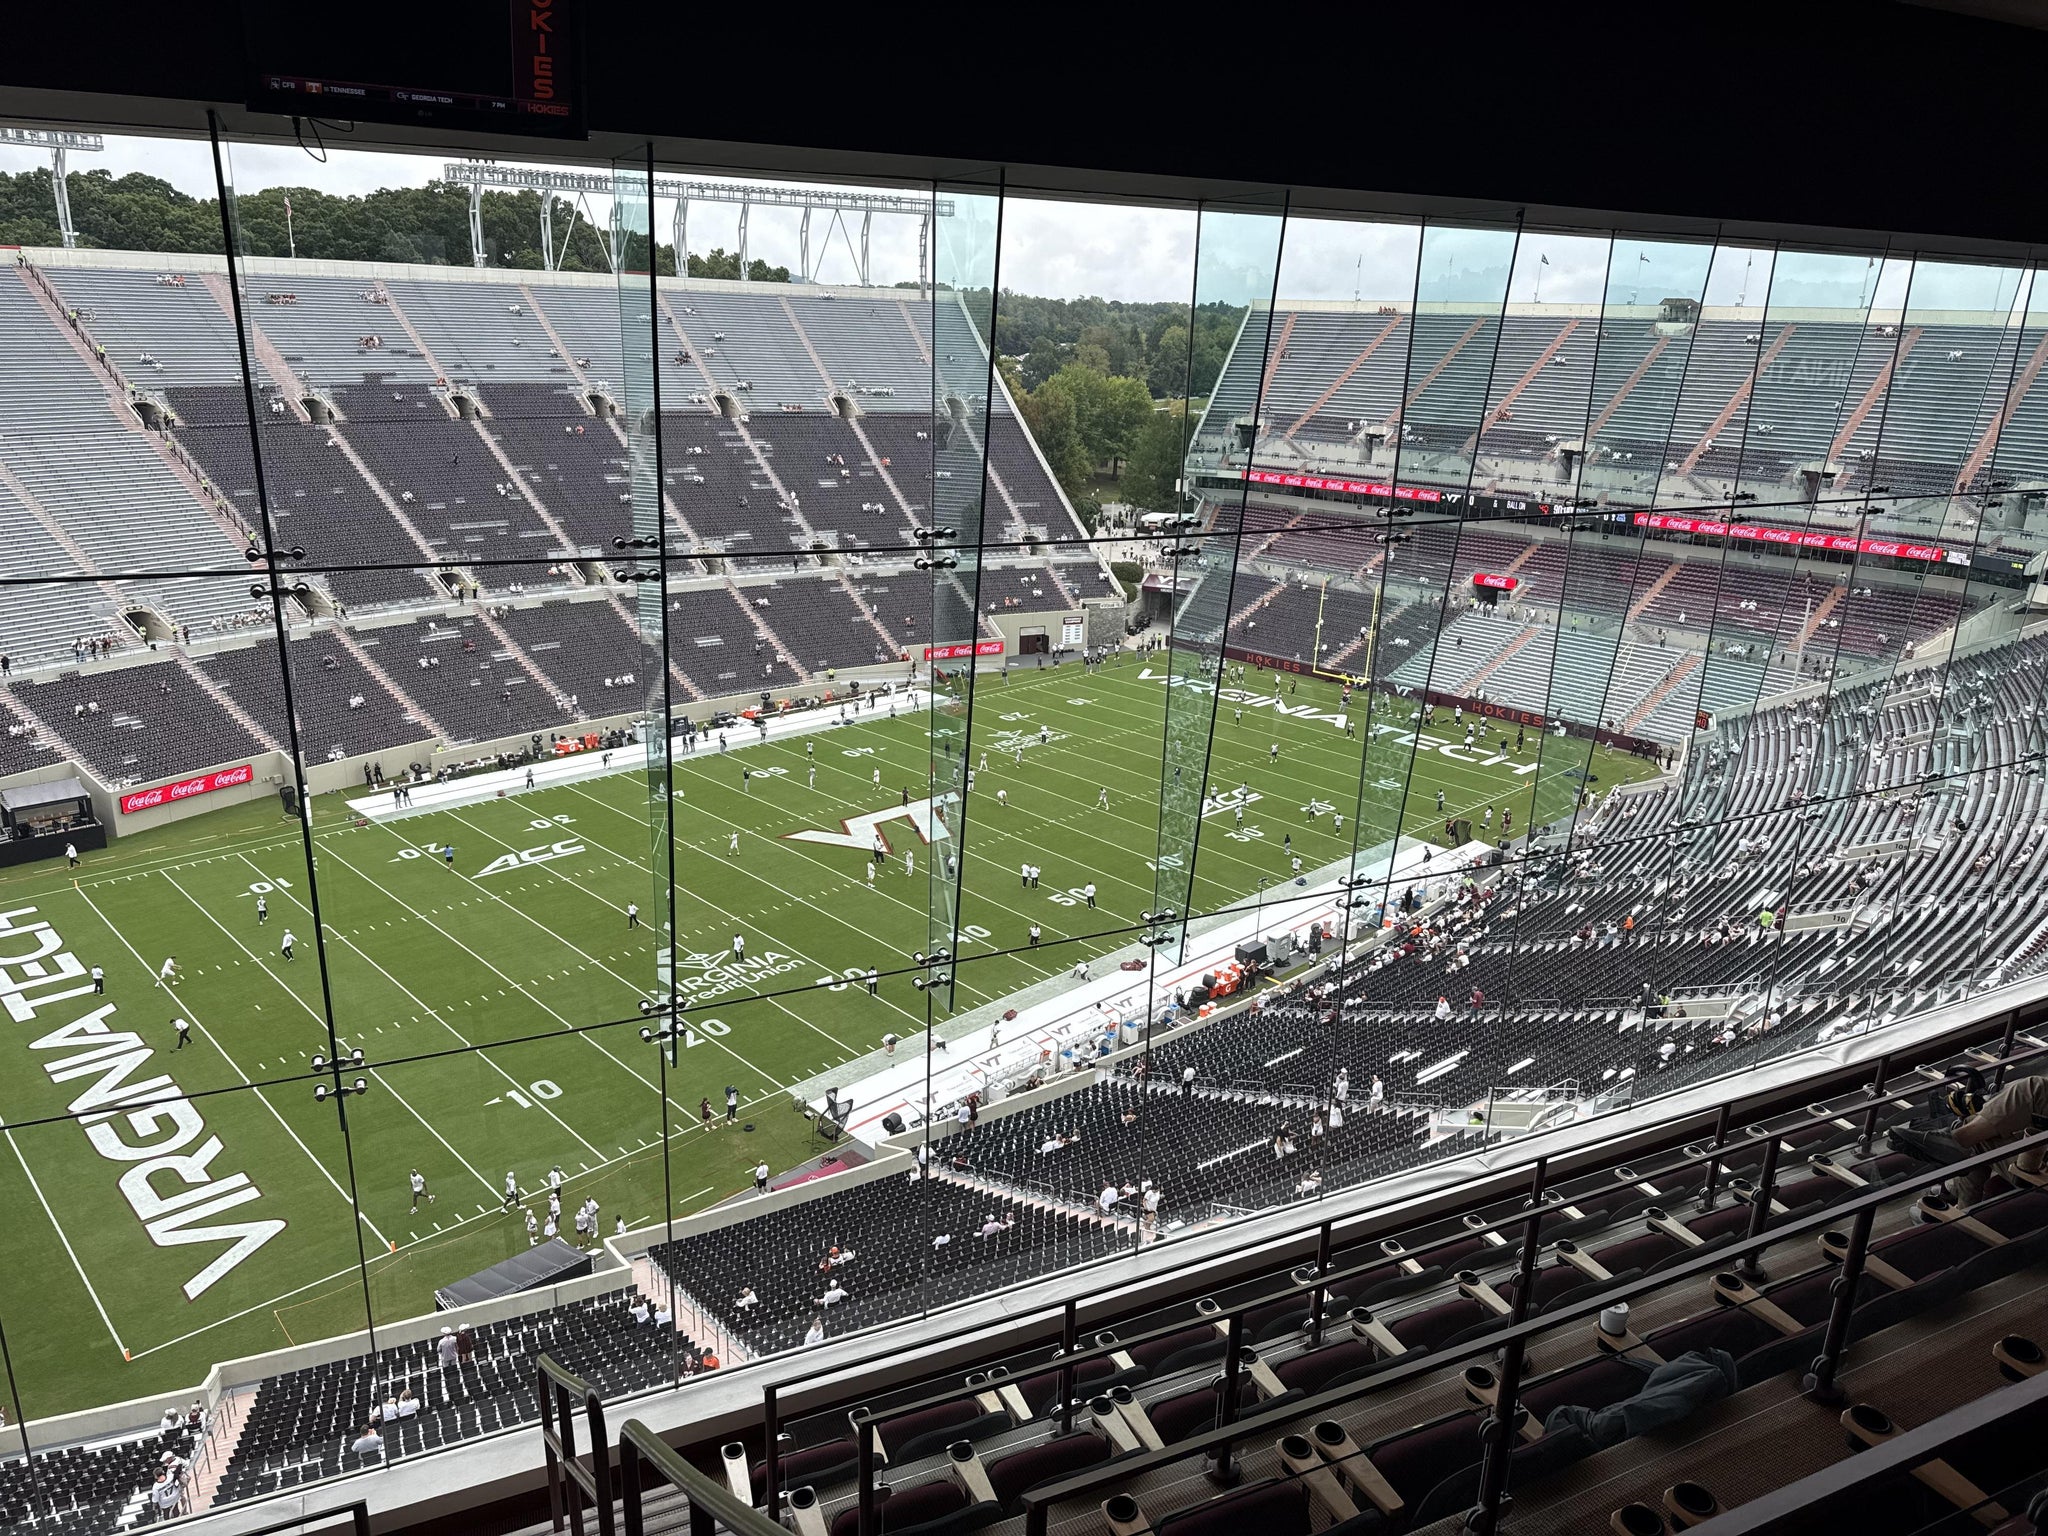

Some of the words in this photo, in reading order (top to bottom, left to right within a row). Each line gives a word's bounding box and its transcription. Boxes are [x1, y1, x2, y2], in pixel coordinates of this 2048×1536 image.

[330, 86, 366, 96] TENNESSEE
[411, 94, 437, 102] GEORGIA
[528, 103, 569, 116] HOKIES
[1138, 668, 1348, 729] VIRGINIA
[1366, 723, 1545, 776] TECH
[1472, 702, 1544, 726] HOKIES
[476, 837, 585, 876] ACC
[740, 958, 806, 983] Union
[506, 1079, 563, 1109] 10
[27, 1002, 290, 1304] VIRGINIA
